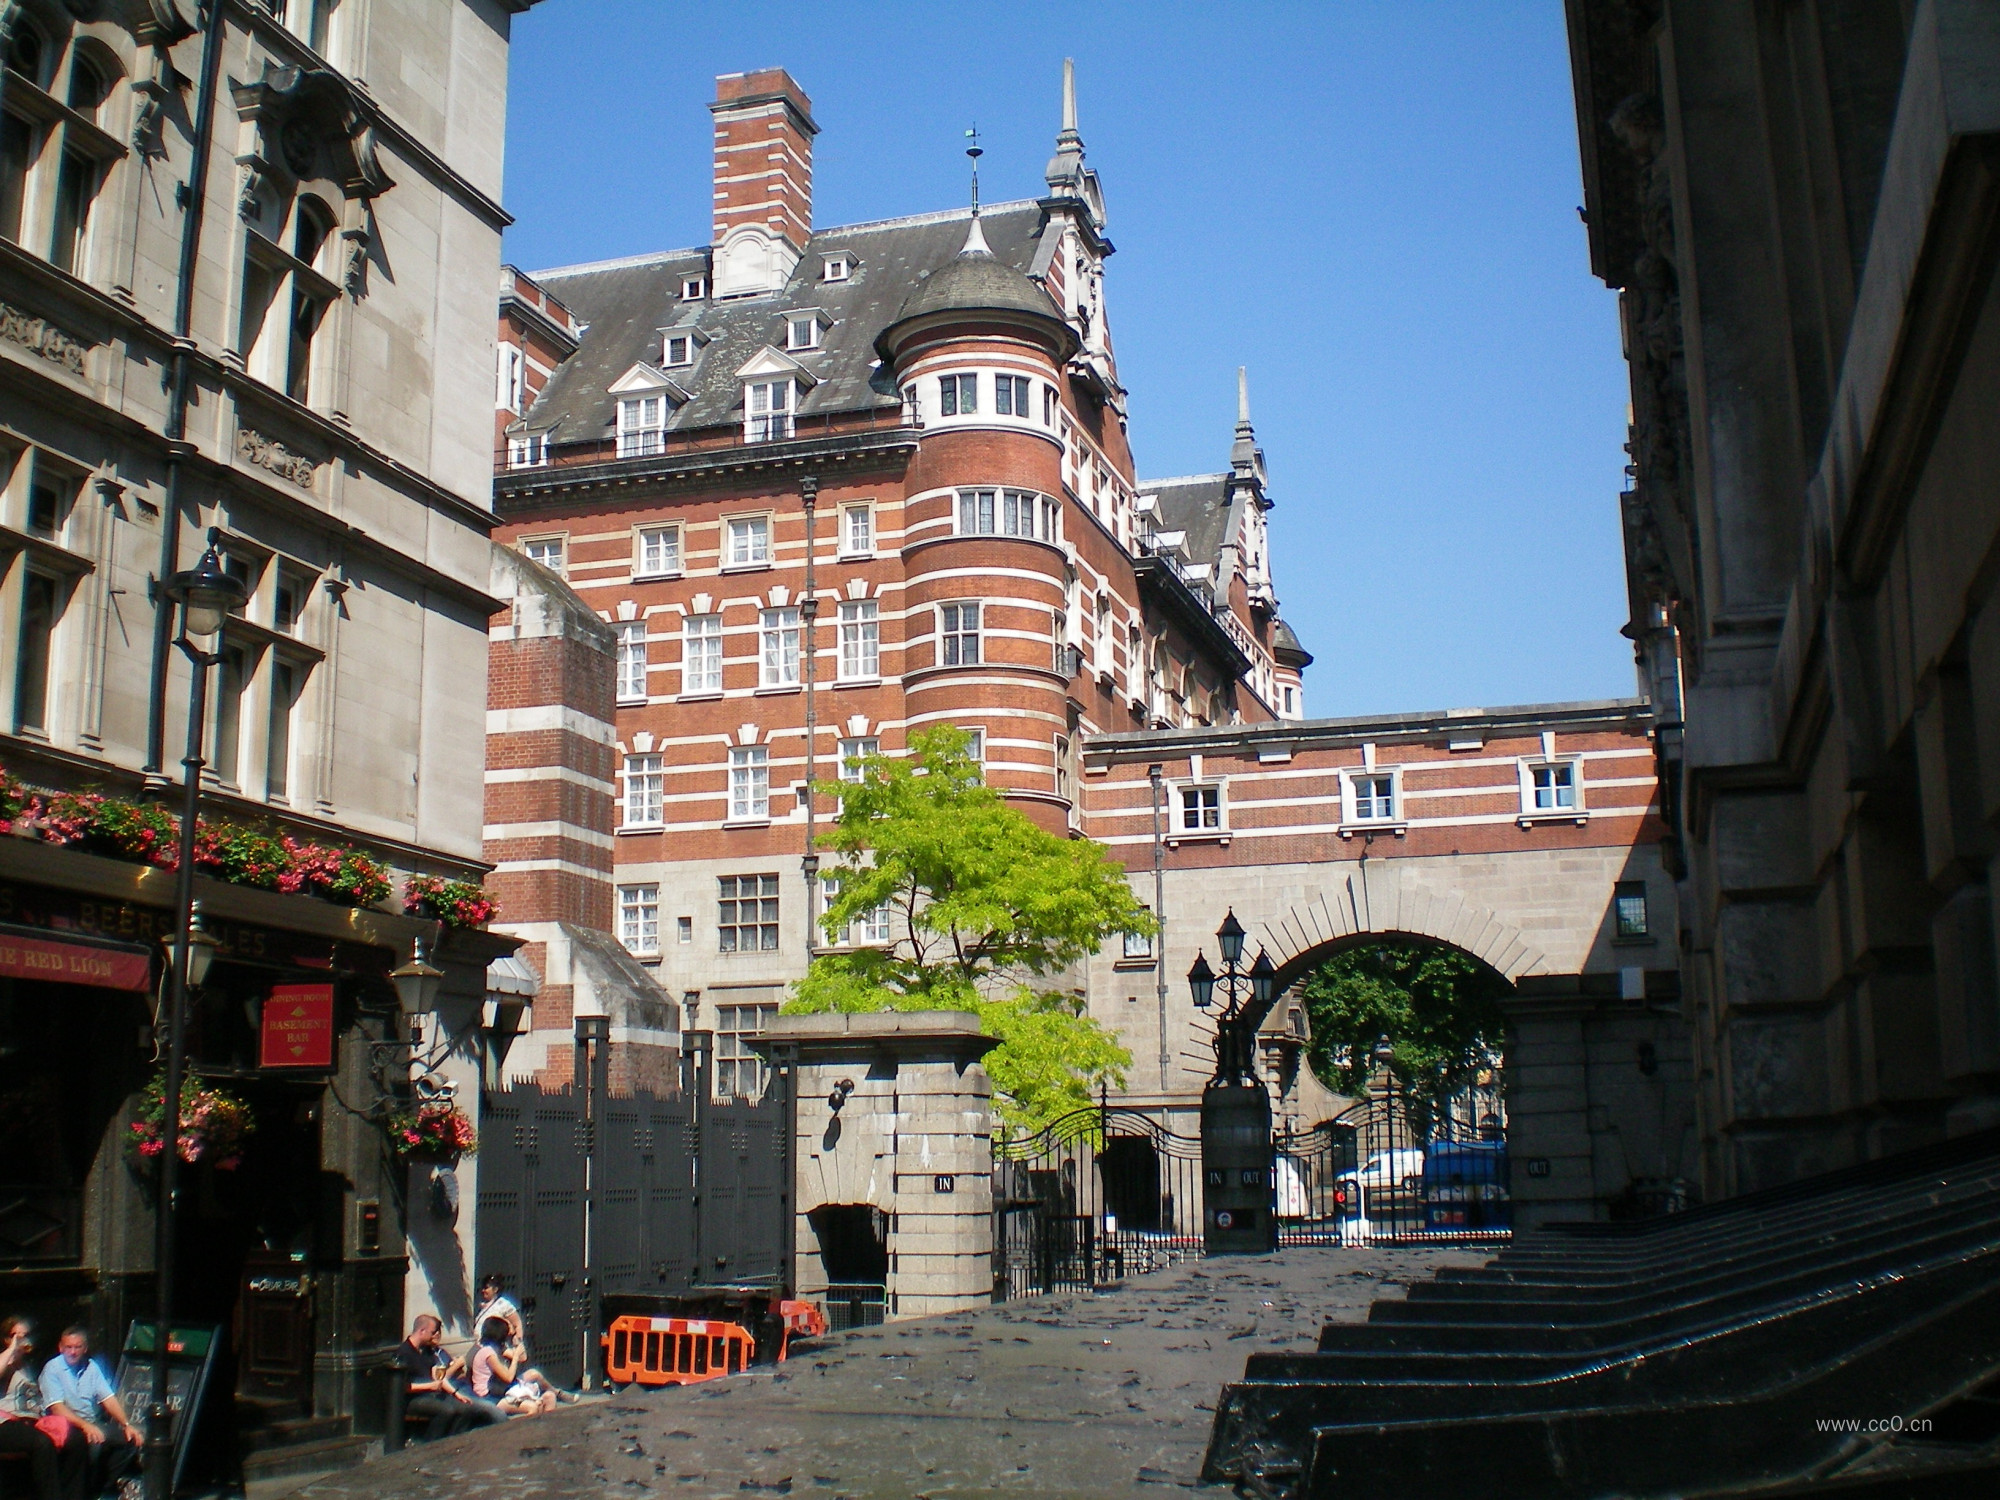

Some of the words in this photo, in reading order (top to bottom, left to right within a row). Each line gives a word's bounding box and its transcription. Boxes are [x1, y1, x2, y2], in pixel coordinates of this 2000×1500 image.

[23, 950, 63, 970] RED
[69, 956, 112, 977] LION
[270, 1019, 327, 1030] BASEMENT
[287, 1032, 308, 1043] BAR
[1210, 1172, 1221, 1184] IN
[1243, 1171, 1260, 1183] OUT
[939, 1177, 951, 1190] IN
